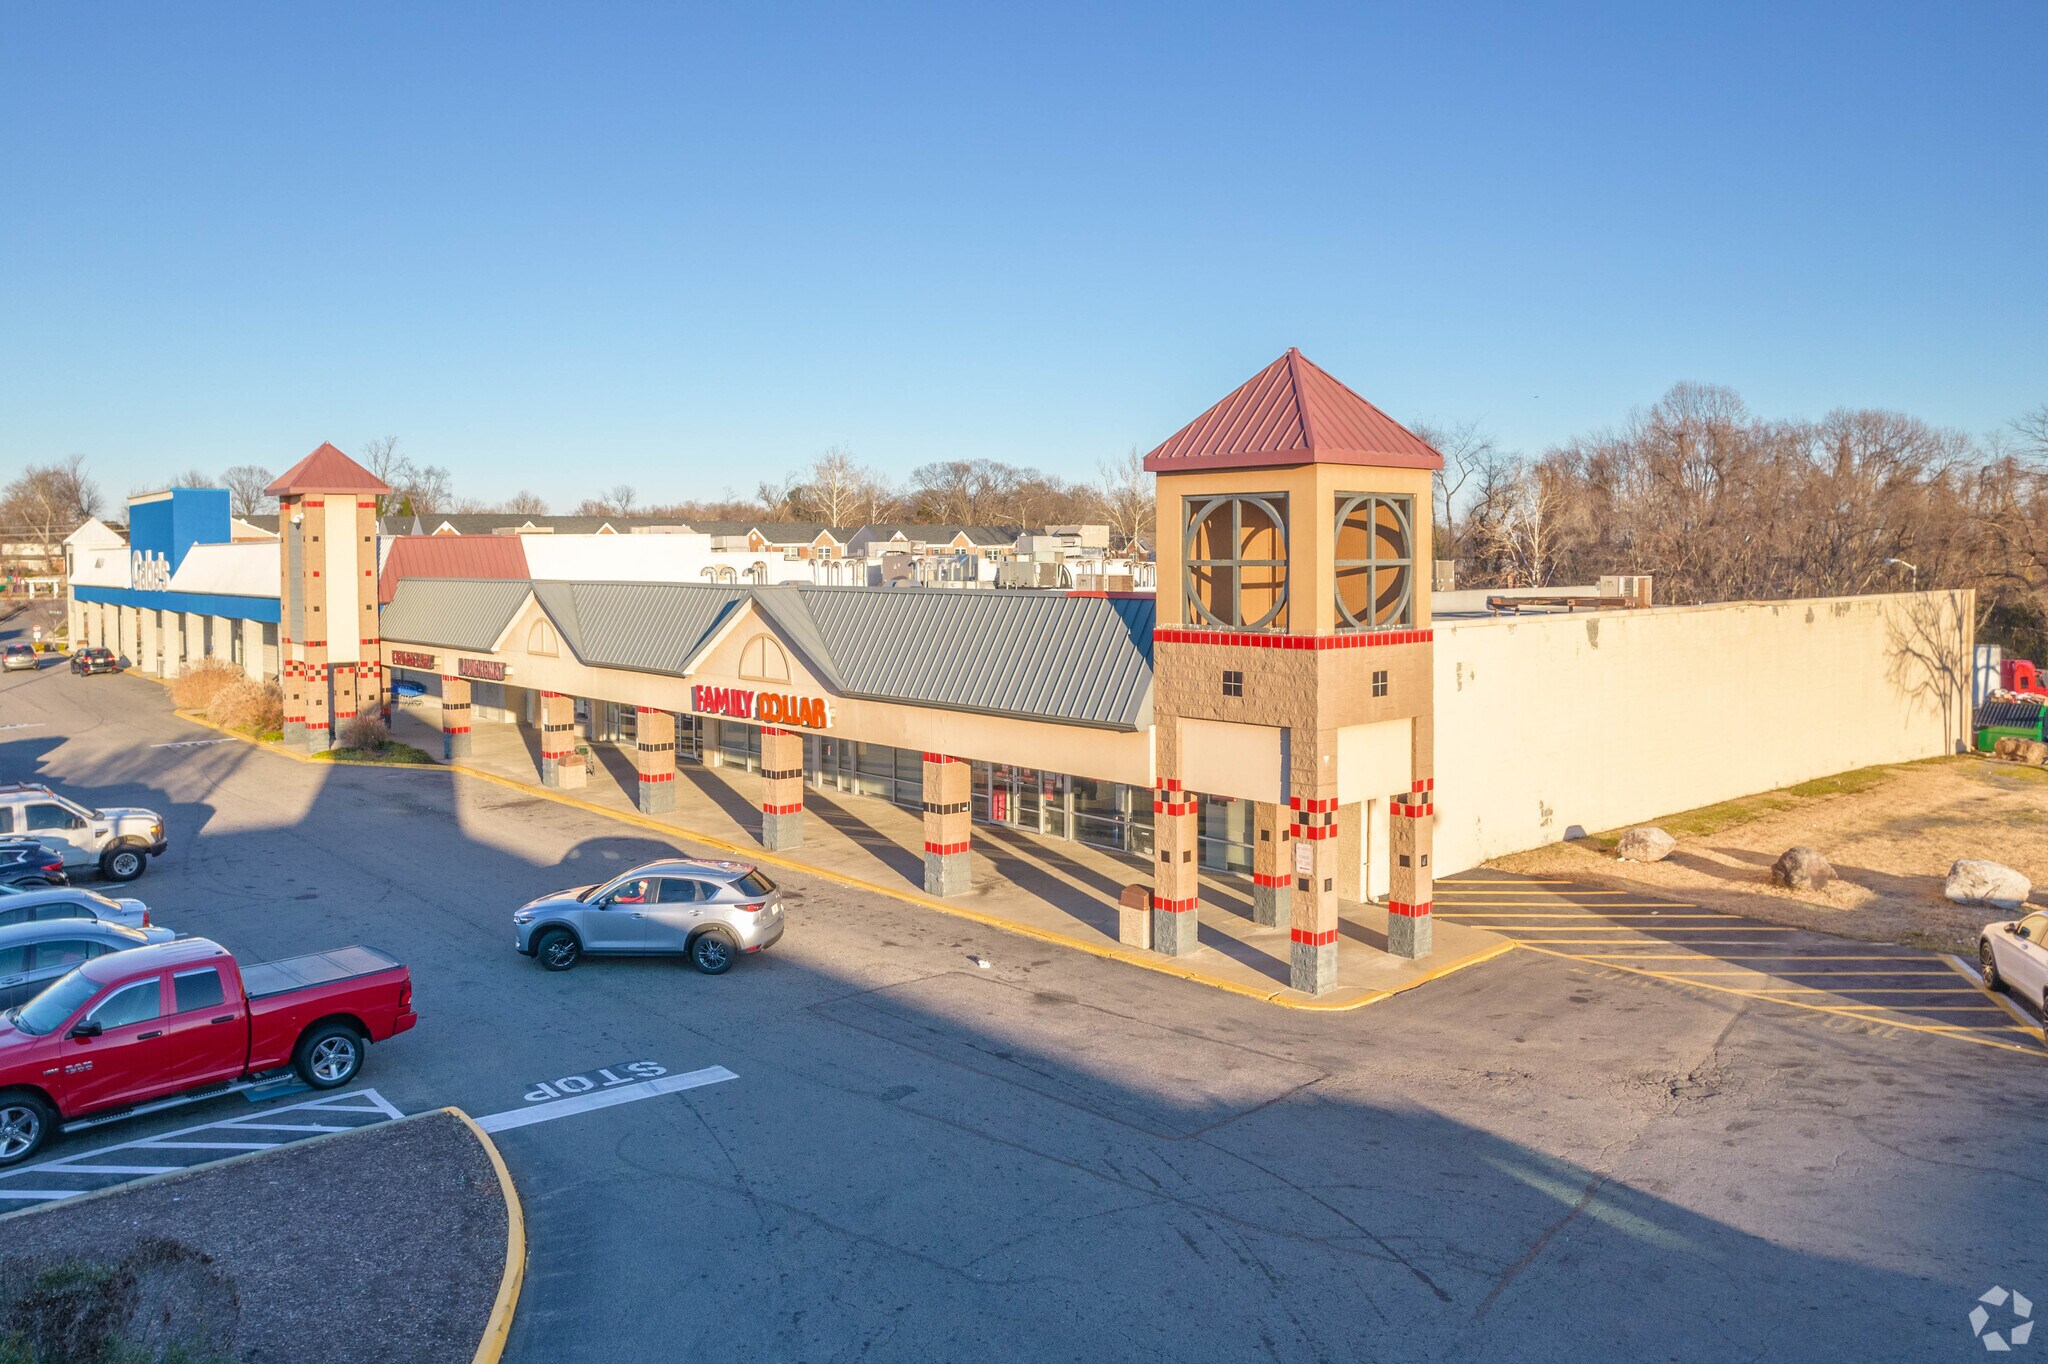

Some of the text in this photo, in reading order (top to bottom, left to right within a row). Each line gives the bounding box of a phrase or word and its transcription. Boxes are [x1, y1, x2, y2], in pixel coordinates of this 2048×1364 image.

[693, 684, 828, 728] FAMILY DOLLAR
[524, 1061, 667, 1102] STOP
